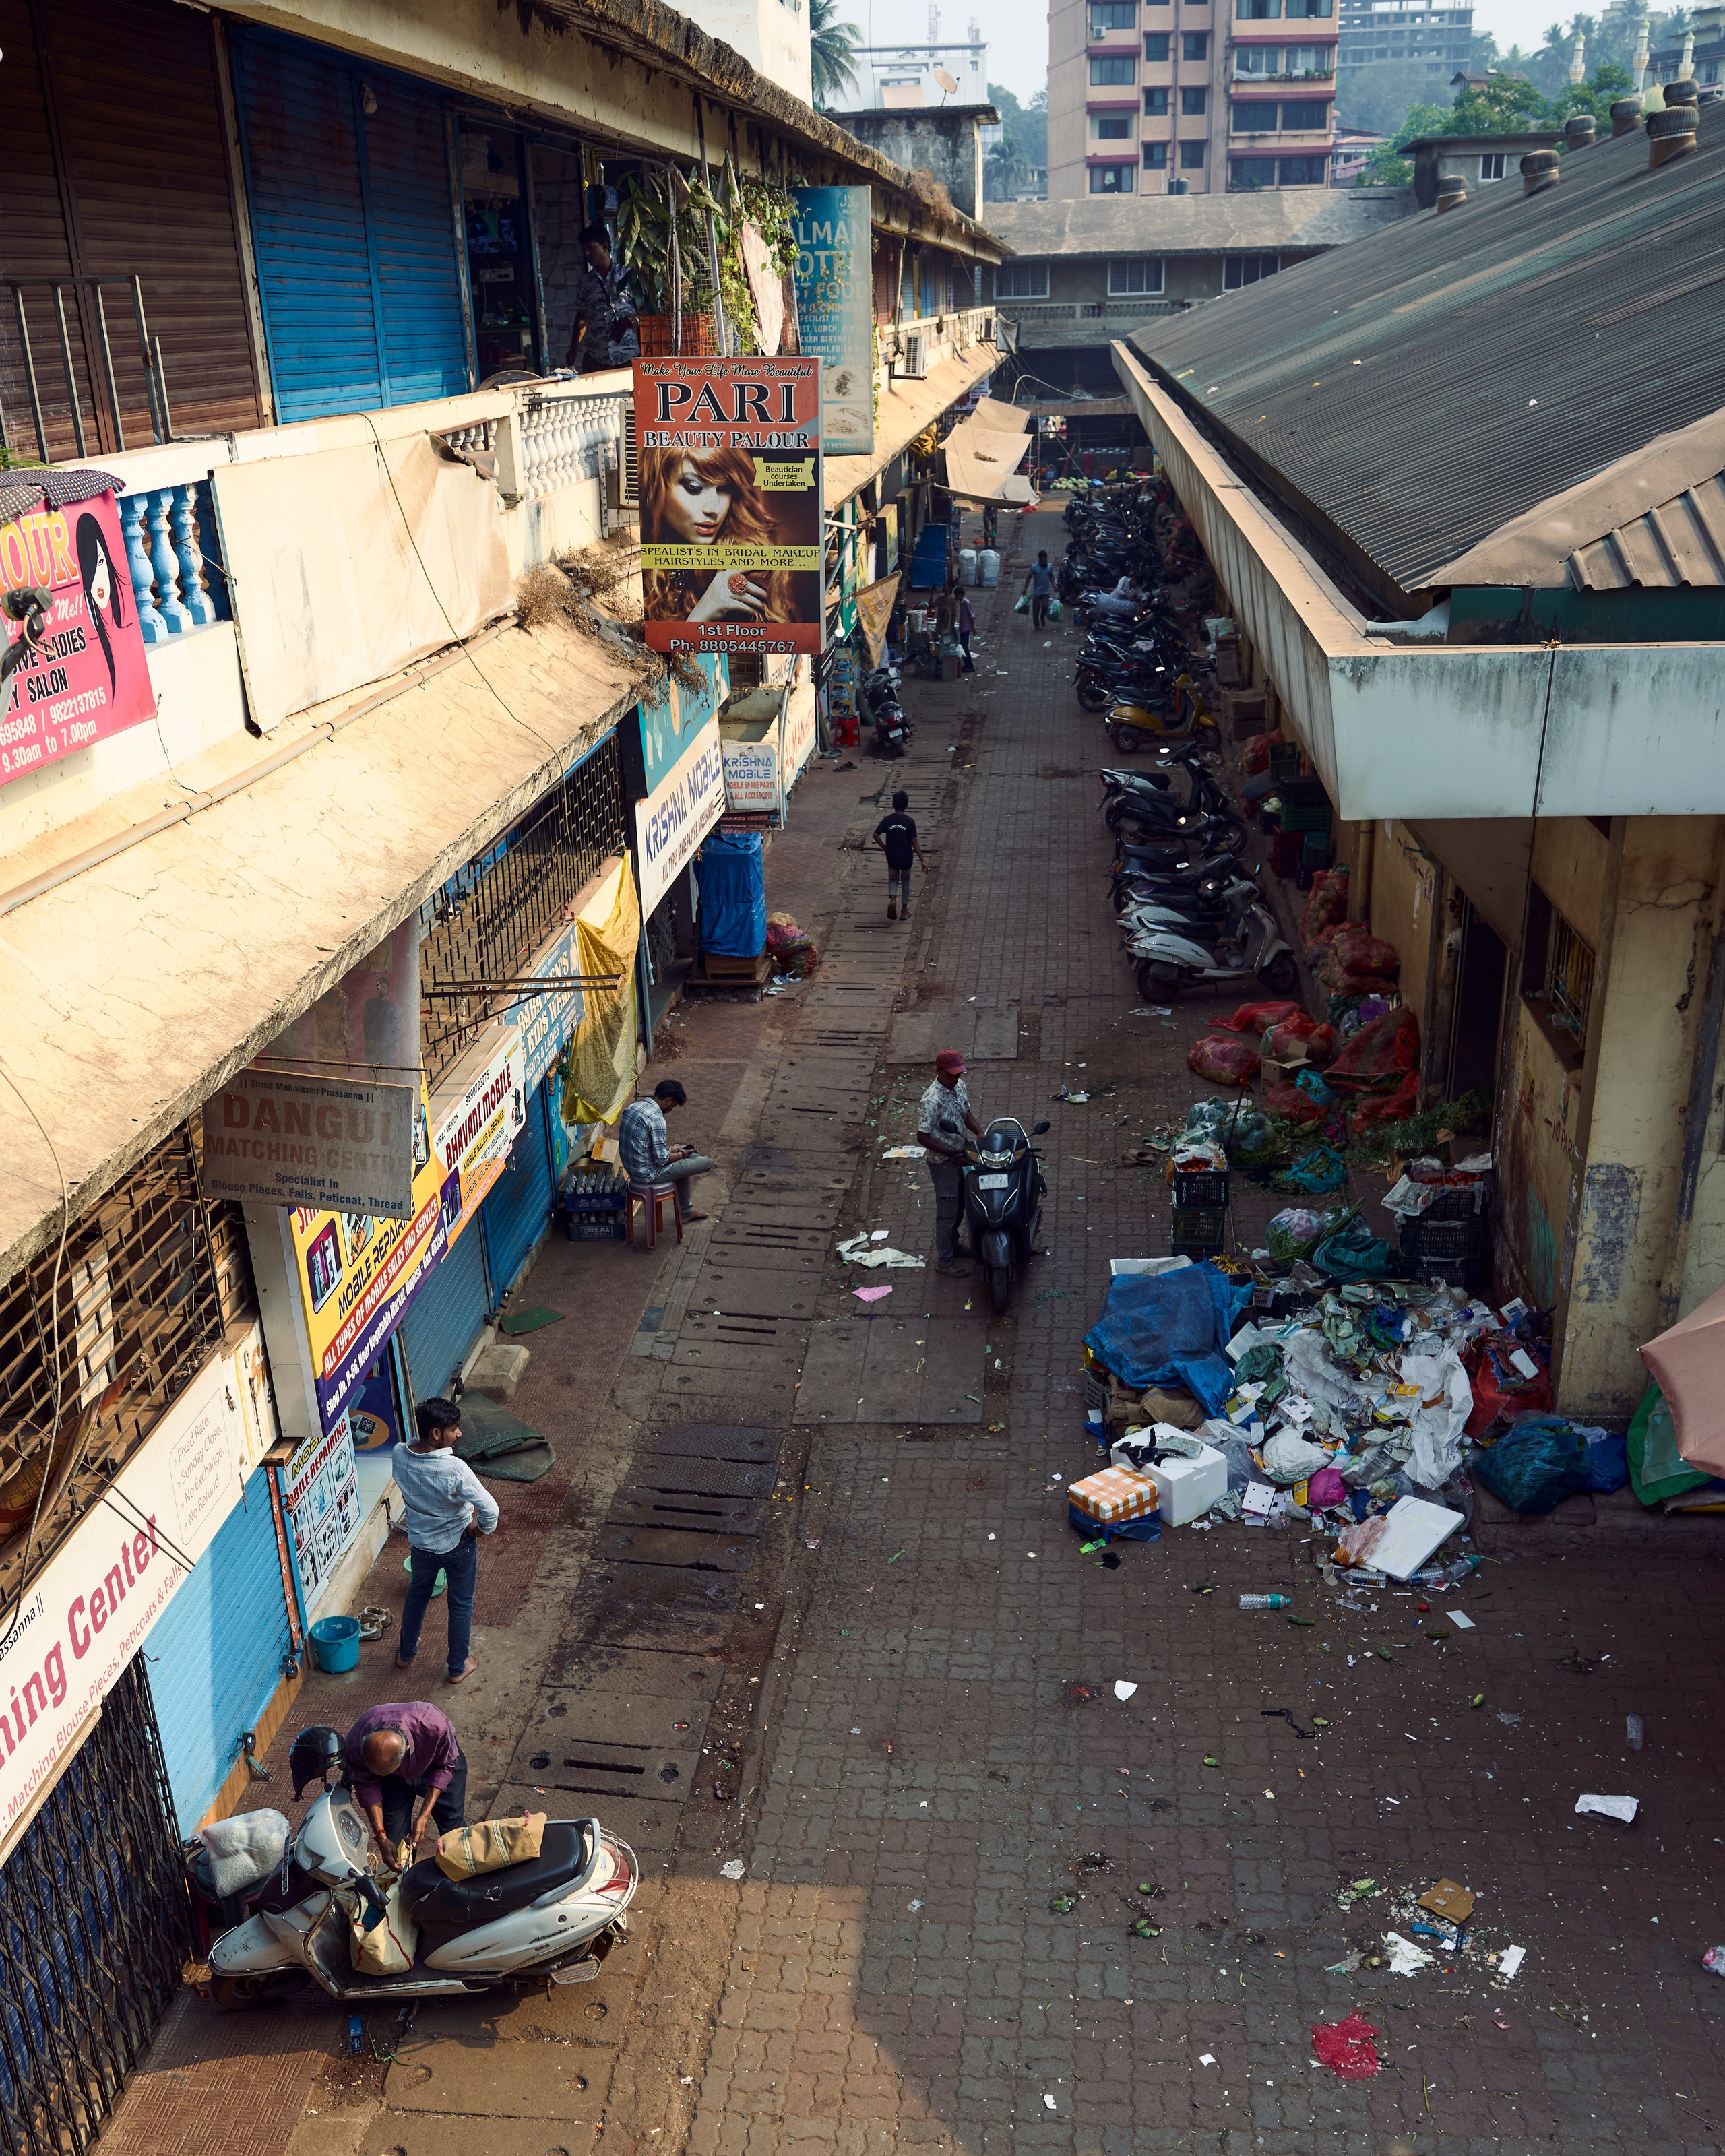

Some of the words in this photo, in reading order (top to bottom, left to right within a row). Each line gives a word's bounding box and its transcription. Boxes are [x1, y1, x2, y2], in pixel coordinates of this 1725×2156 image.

[816, 282, 867, 299] FOOD
[640, 362, 671, 376] Make
[674, 363, 703, 380] Your
[704, 363, 729, 380] Life
[731, 363, 760, 377] More
[763, 363, 813, 381] Beautiful
[654, 381, 798, 424] PARI
[644, 431, 724, 448] BEAUTY
[731, 431, 810, 449] PALOUR
[0, 510, 80, 597] OUR
[640, 547, 703, 556] SPEALIST'S
[55, 594, 83, 621] Me!!
[42, 627, 86, 662] LADIES
[670, 639, 695, 652] Ph;
[699, 640, 796, 652] 8805445767
[697, 624, 723, 636] 1st
[726, 624, 767, 637] Floor
[26, 666, 69, 704] SALON
[49, 686, 106, 726] 9822137815
[1, 742, 42, 773] 9.30am
[45, 735, 58, 754] to
[60, 719, 98, 747] 7.00pm
[734, 792, 744, 800] ALL
[517, 993, 543, 1037] BABA
[526, 1009, 549, 1058] KIDS
[548, 982, 574, 1025] WEAR
[526, 1050, 540, 1082] GENTS
[540, 1046, 545, 1059] &
[544, 1023, 560, 1053] LADIES
[531, 1062, 545, 1091] INNER
[544, 1043, 557, 1070] WEAR
[251, 1079, 273, 1090] Shree
[276, 1082, 319, 1096] Mahalaxmi
[321, 1087, 363, 1100] Prassanna
[223, 1093, 391, 1146] DANGUI
[445, 1102, 482, 1172] BHAVANI
[482, 1063, 512, 1122] MOBILE
[1552, 1118, 1561, 1143] NO
[206, 1135, 318, 1166] MATCHING
[463, 1147, 477, 1172] MOBILE
[476, 1132, 489, 1156] SALES
[491, 1109, 505, 1135] SERVICE
[211, 1179, 245, 1192] Blouse
[248, 1183, 286, 1198] Pieces,
[288, 1188, 316, 1202] Falls,
[319, 1192, 365, 1208] Peticoat,
[368, 1197, 404, 1211] Thread
[276, 1172, 326, 1188] Specialist
[329, 1178, 339, 1188] In
[324, 1348, 337, 1375] ALL
[335, 1322, 356, 1356] TYPES
[355, 1306, 365, 1327] OF
[364, 1273, 389, 1317] MOBILE
[387, 1246, 405, 1281] SALES
[404, 1232, 416, 1258] AND
[415, 1195, 438, 1240] SERVICE
[338, 1254, 373, 1321] MOBILE
[325, 1388, 340, 1418] Shop
[338, 1376, 348, 1400] No.
[346, 1358, 360, 1387] B-66,
[358, 1343, 371, 1369] Near
[368, 1312, 391, 1350] Vegetable
[389, 1289, 408, 1324] Market,
[405, 1267, 422, 1298] Mapusa
[422, 1253, 432, 1271] Goa.
[431, 1227, 445, 1259] 403507
[177, 1431, 195, 1463] Fixed
[195, 1416, 210, 1440] Rate.
[181, 1449, 203, 1484] Sunday
[204, 1425, 222, 1452] Close.
[309, 1418, 346, 1480] REPAIRING
[185, 1487, 195, 1505] No
[194, 1447, 224, 1492] Exchange.
[188, 1507, 198, 1526] No
[198, 1473, 221, 1509] Refund.
[67, 1512, 159, 1660] Center
[7, 1746, 57, 1819] Matching
[56, 1702, 88, 1750] Blouse
[88, 1657, 120, 1704] Pieces,
[119, 1602, 157, 1659] Peticoats
[158, 1587, 164, 1602] &
[164, 1564, 182, 1595] Falls
